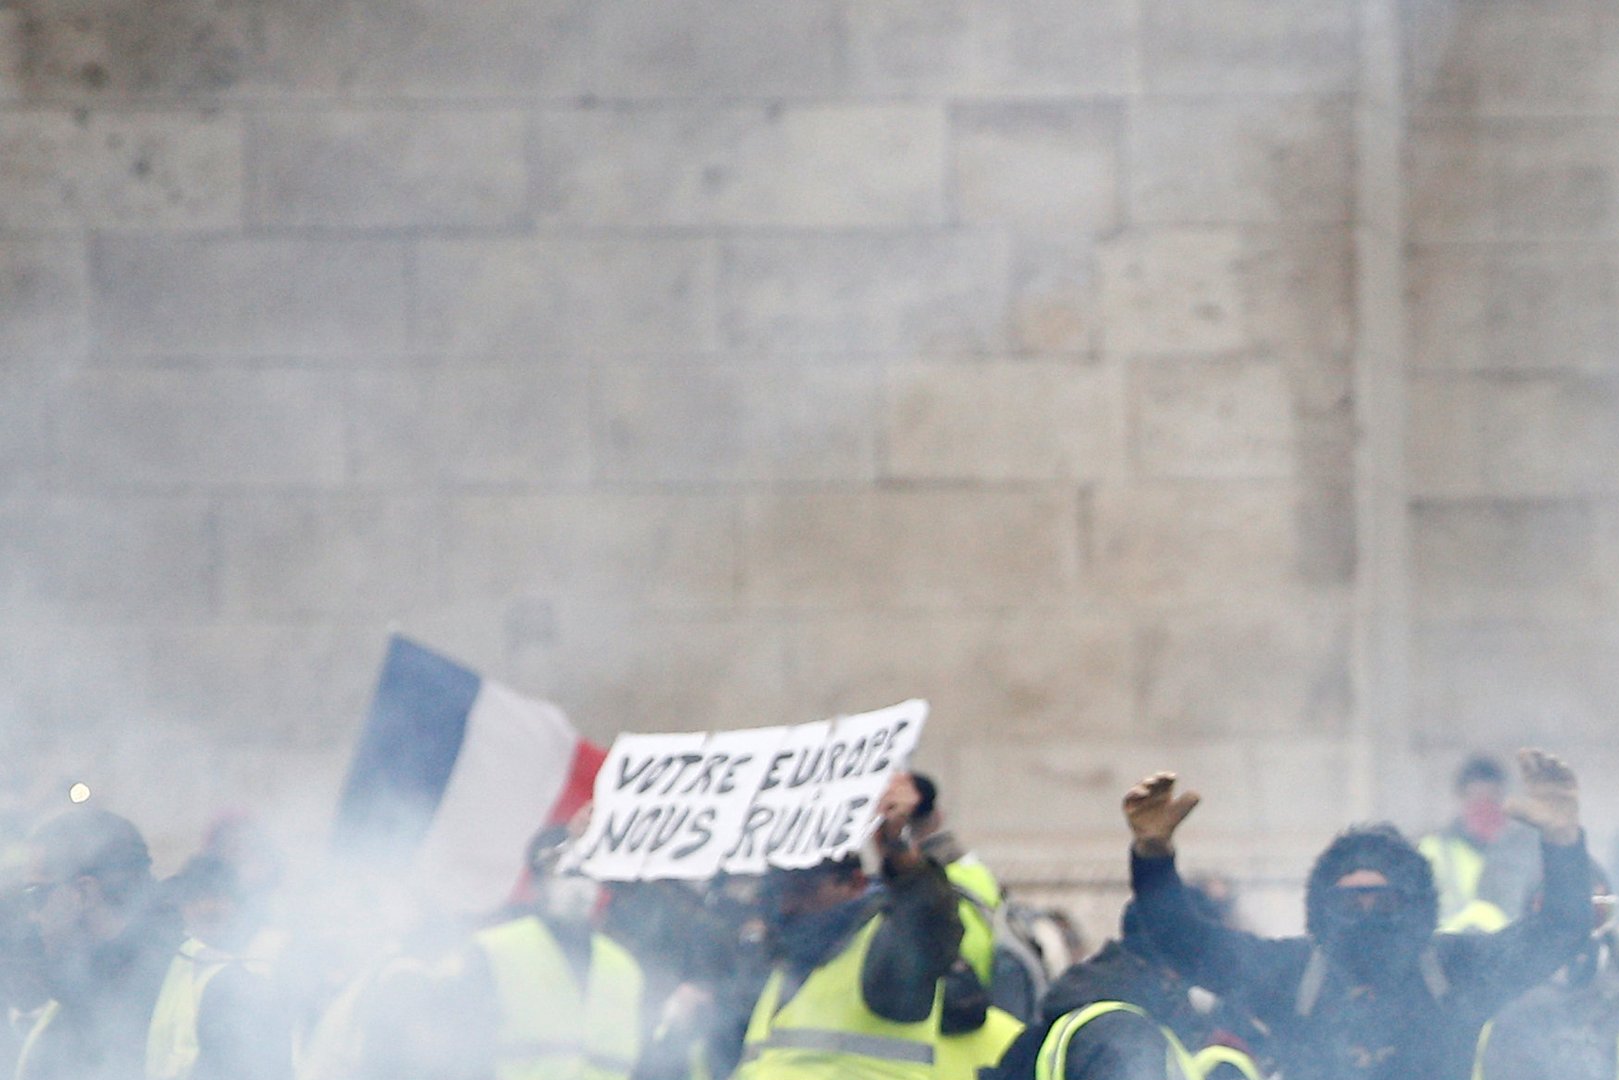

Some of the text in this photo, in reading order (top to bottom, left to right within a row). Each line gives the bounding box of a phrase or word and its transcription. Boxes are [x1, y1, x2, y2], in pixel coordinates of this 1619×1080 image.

[616, 720, 908, 795] VOTRE EUROPE
[585, 804, 716, 859] NOUS
